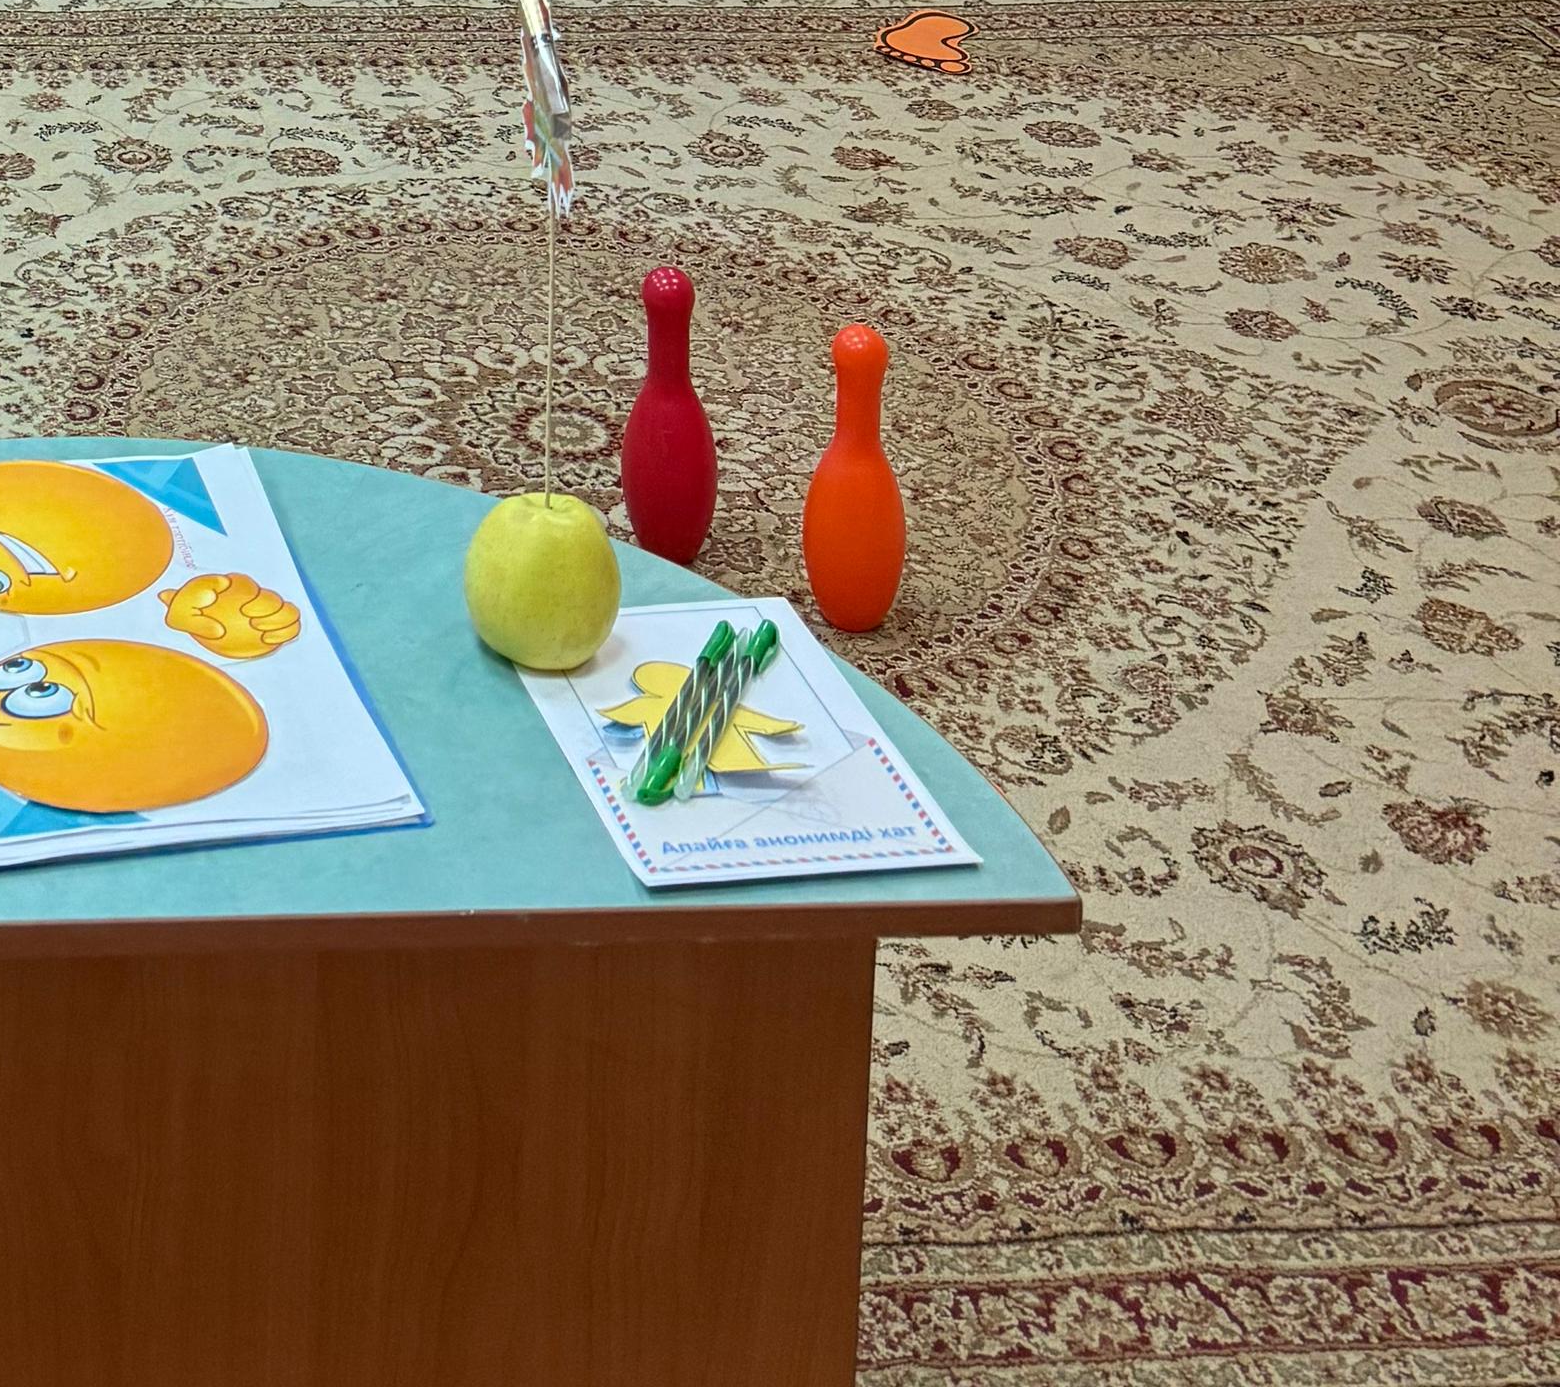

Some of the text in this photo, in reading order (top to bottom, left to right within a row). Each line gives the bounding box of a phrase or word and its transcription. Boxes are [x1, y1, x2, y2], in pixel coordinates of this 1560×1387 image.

[662, 826, 917, 855] Апайға анонимді хат
